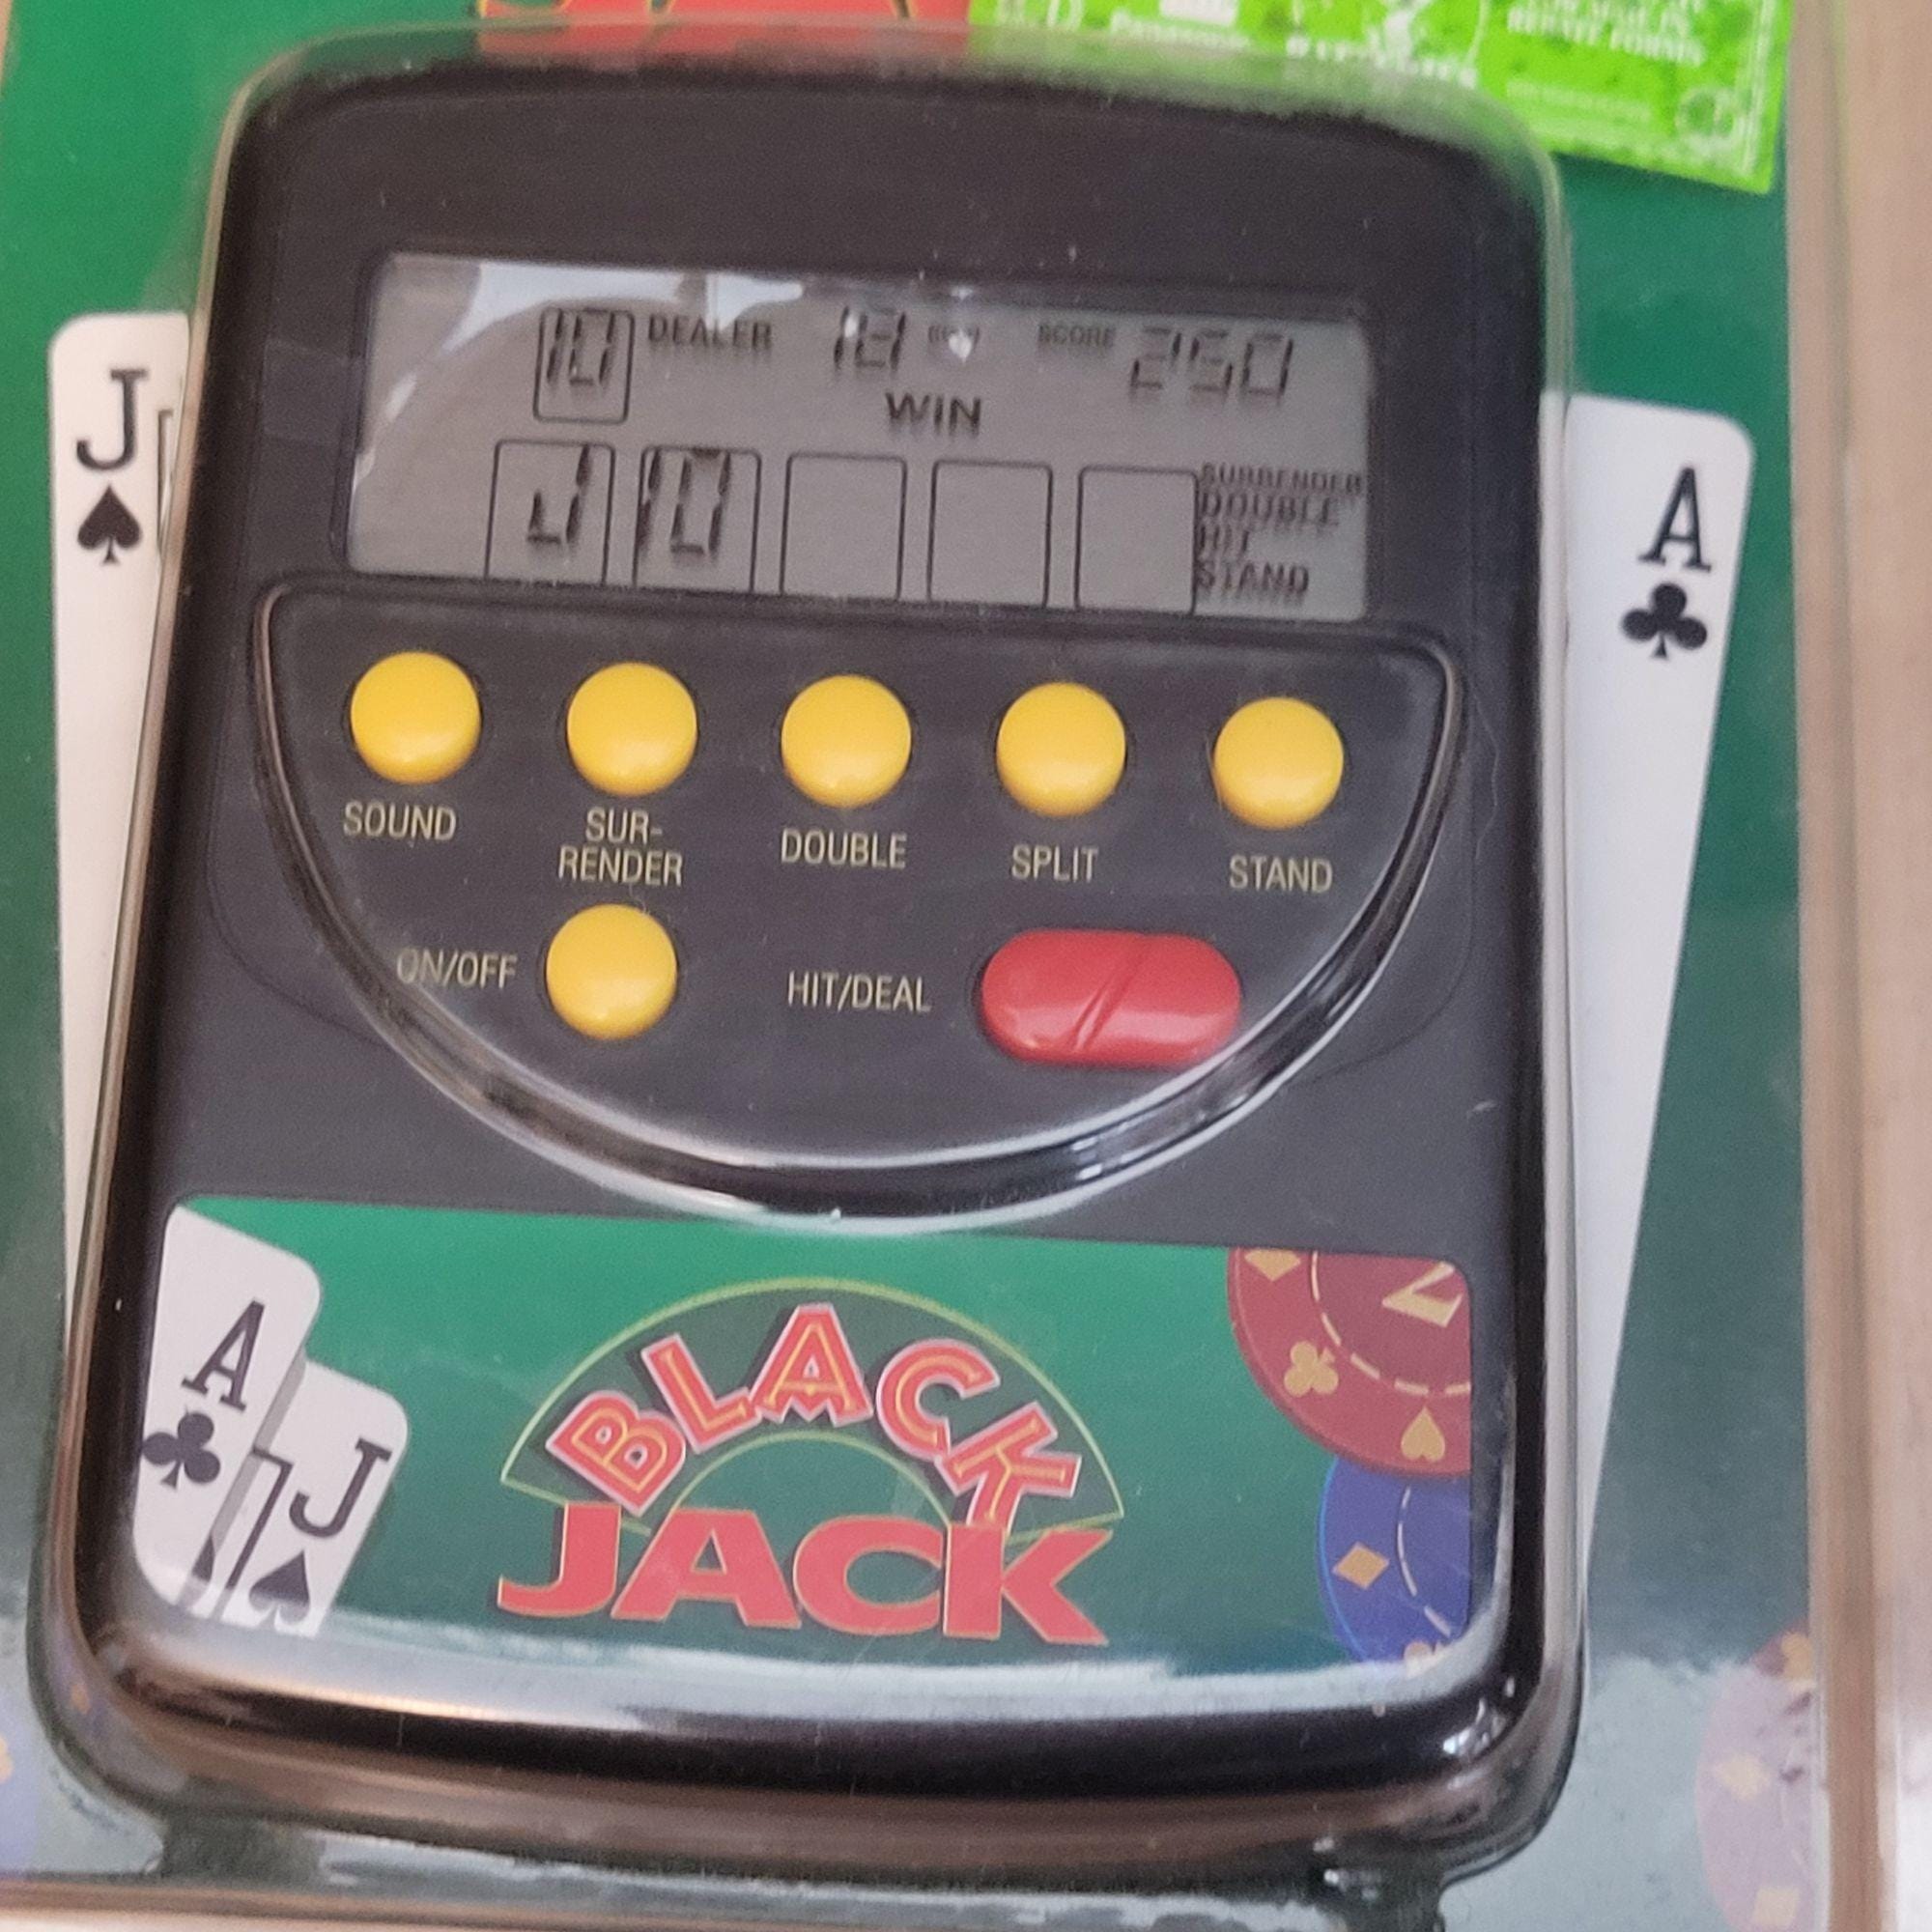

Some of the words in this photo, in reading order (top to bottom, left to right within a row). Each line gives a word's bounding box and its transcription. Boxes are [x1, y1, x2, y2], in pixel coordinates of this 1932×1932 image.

[647, 313, 773, 355] DEALER
[1128, 327, 1293, 396] 250
[75, 367, 148, 471] J
[885, 391, 981, 435] WIN
[1200, 493, 1340, 528] DOUBLE
[1638, 466, 1712, 573] A
[1196, 560, 1310, 599] STAND
[343, 801, 457, 840] SOUND
[585, 808, 663, 846] SUR-
[558, 845, 684, 887] RENDER
[781, 828, 907, 868] DOUBLE
[1010, 843, 1099, 883] SPLIT
[1229, 855, 1333, 893] STAND
[396, 948, 517, 989] ON/OFF
[786, 971, 932, 1013] HIT/DEAL
[182, 1298, 266, 1412] A
[546, 1302, 1083, 1534] BLACK
[289, 1437, 393, 1539] J
[497, 1502, 1114, 1645] JACK
